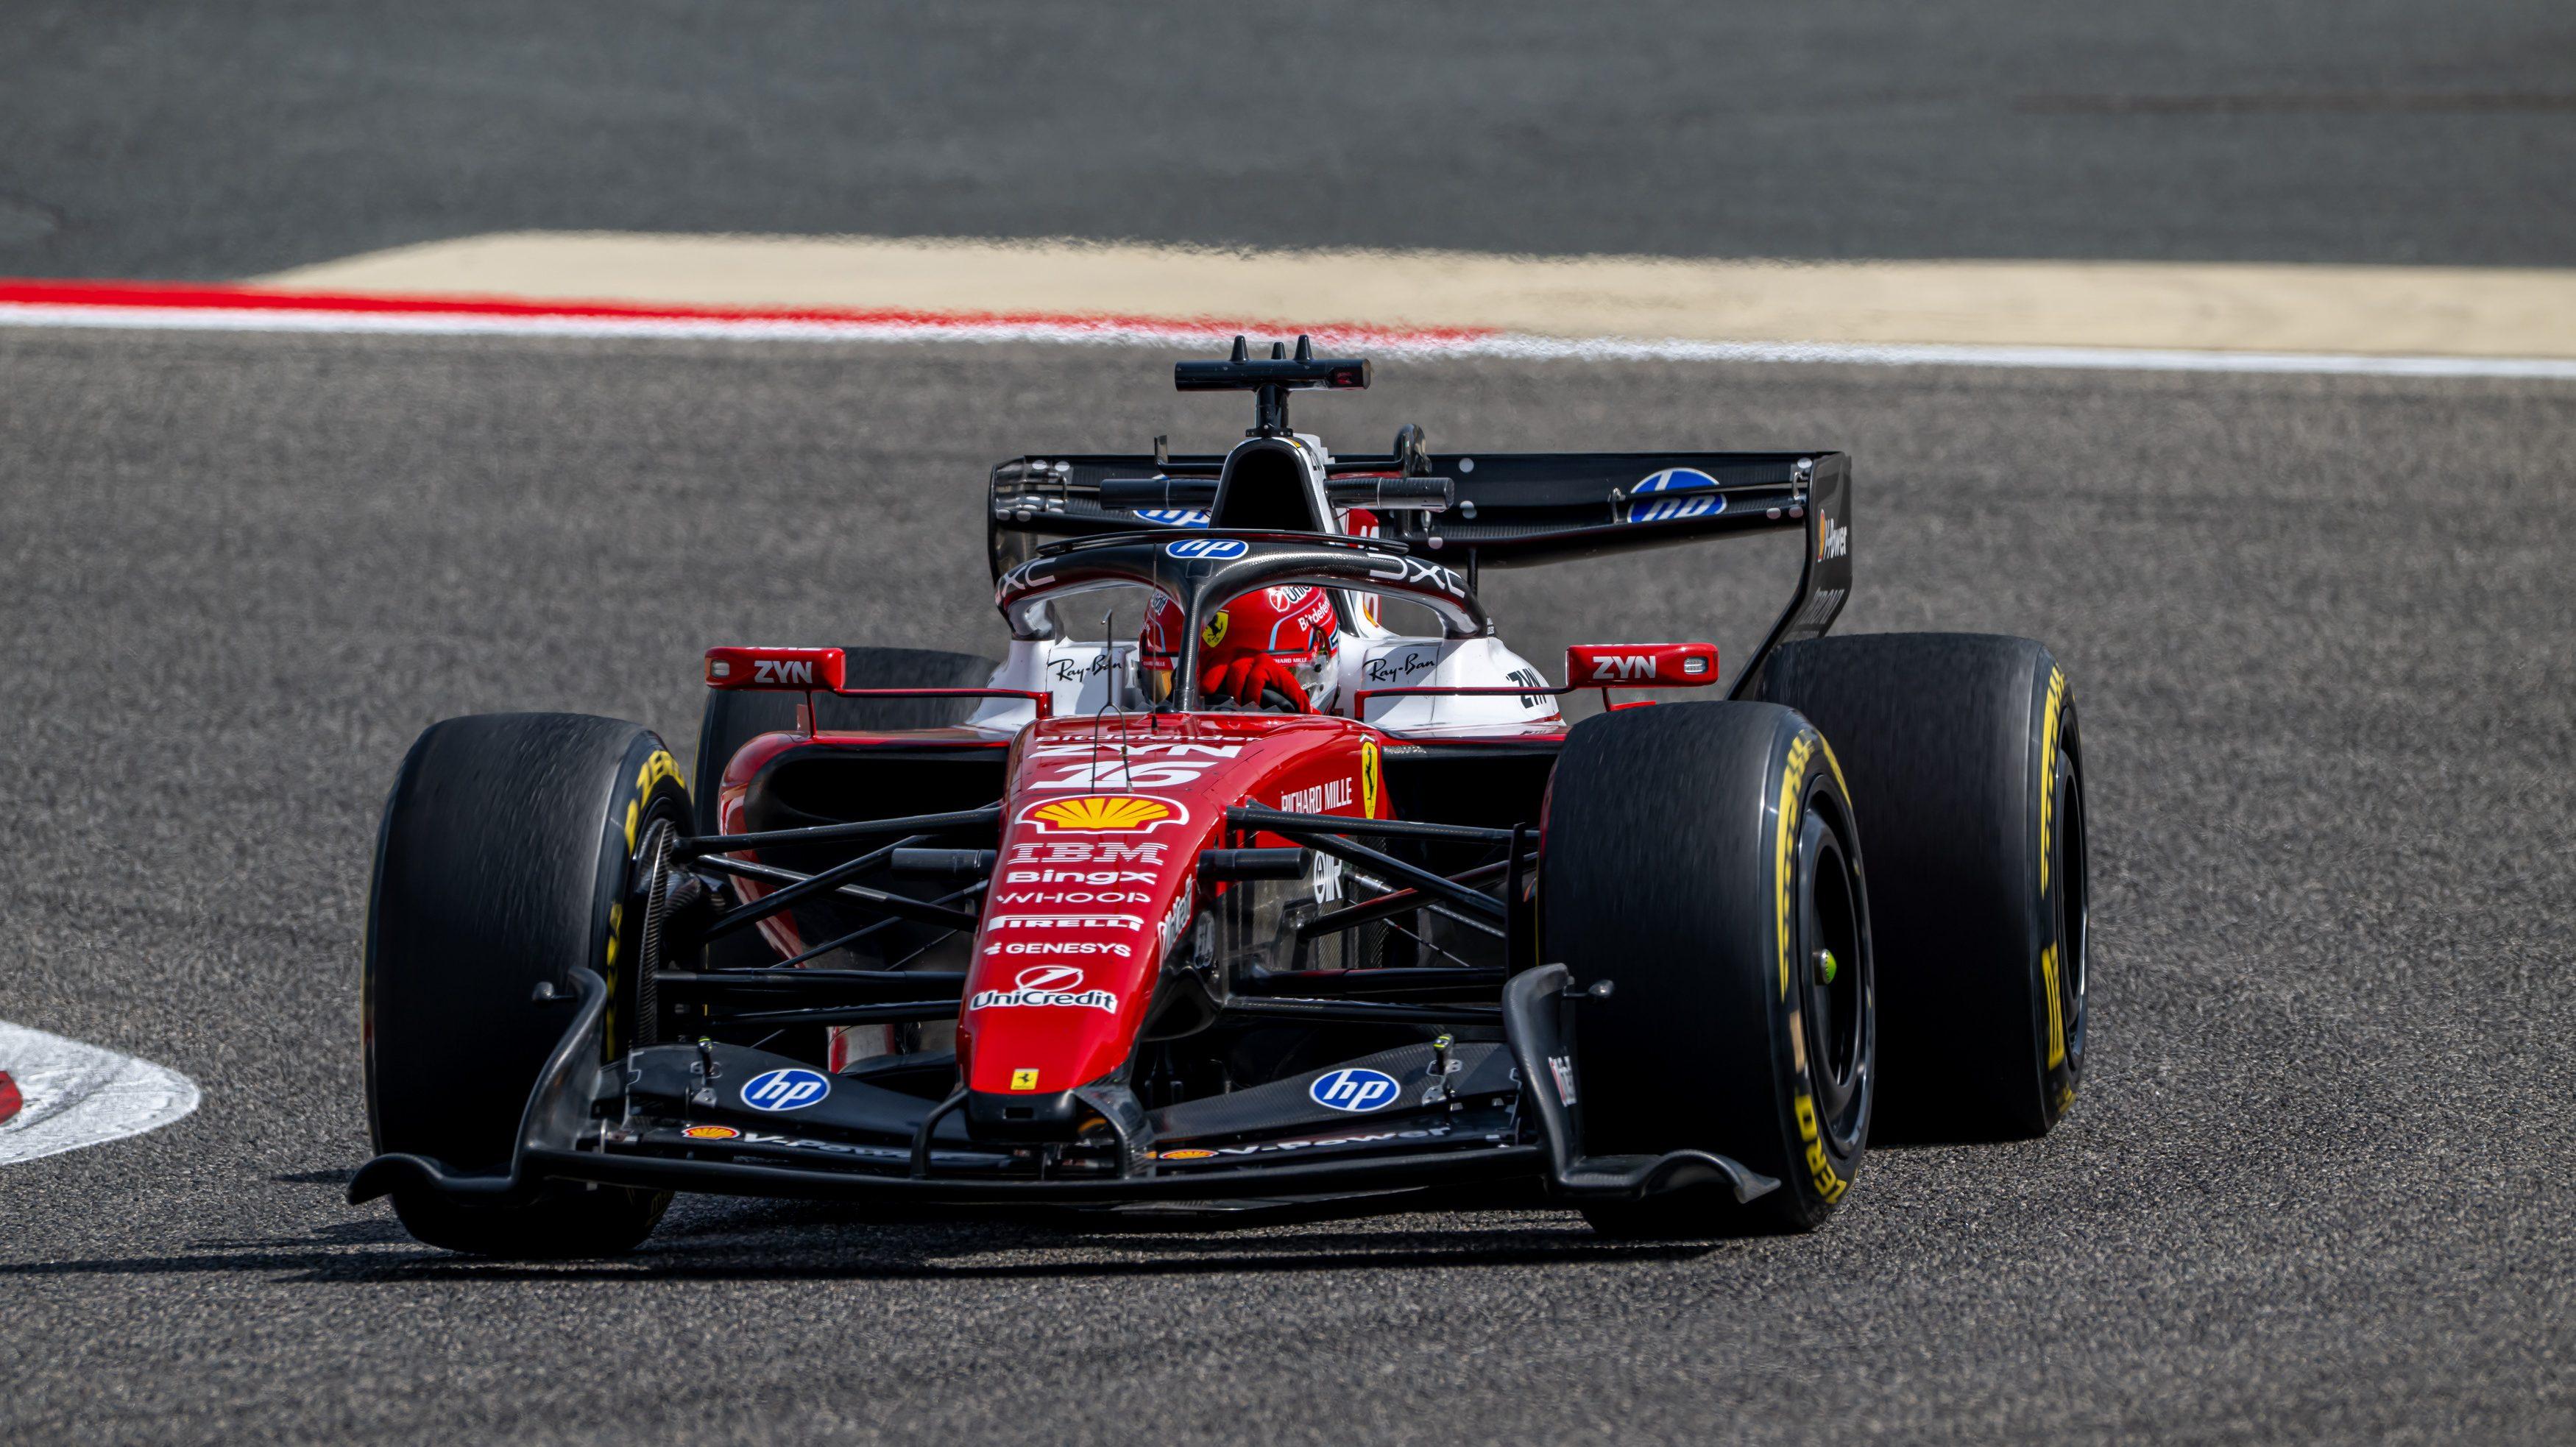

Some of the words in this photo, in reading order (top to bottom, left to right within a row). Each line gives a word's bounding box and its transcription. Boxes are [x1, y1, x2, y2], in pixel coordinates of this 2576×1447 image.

[1176, 539, 1239, 558] hp
[1367, 552, 1465, 598] DXC
[754, 660, 813, 684] ZYN
[1047, 654, 1122, 682] Ray-Ban
[1362, 653, 1435, 682] Ray-Ban
[1593, 655, 1656, 679] ZYN
[1028, 743, 1245, 758] ZYN
[1027, 760, 1219, 790] 16
[1281, 785, 1322, 814] RICHARD
[1325, 777, 1352, 810] MILLE
[1008, 843, 1168, 866] IBM
[1006, 869, 1158, 885] BingX
[996, 892, 1151, 904] WHOOP
[987, 914, 1144, 932] PIRELLI
[1005, 943, 1131, 958] GENESYS
[972, 990, 1117, 1012] UniCredit
[751, 1071, 814, 1110] hp
[1323, 1071, 1390, 1111] hp
